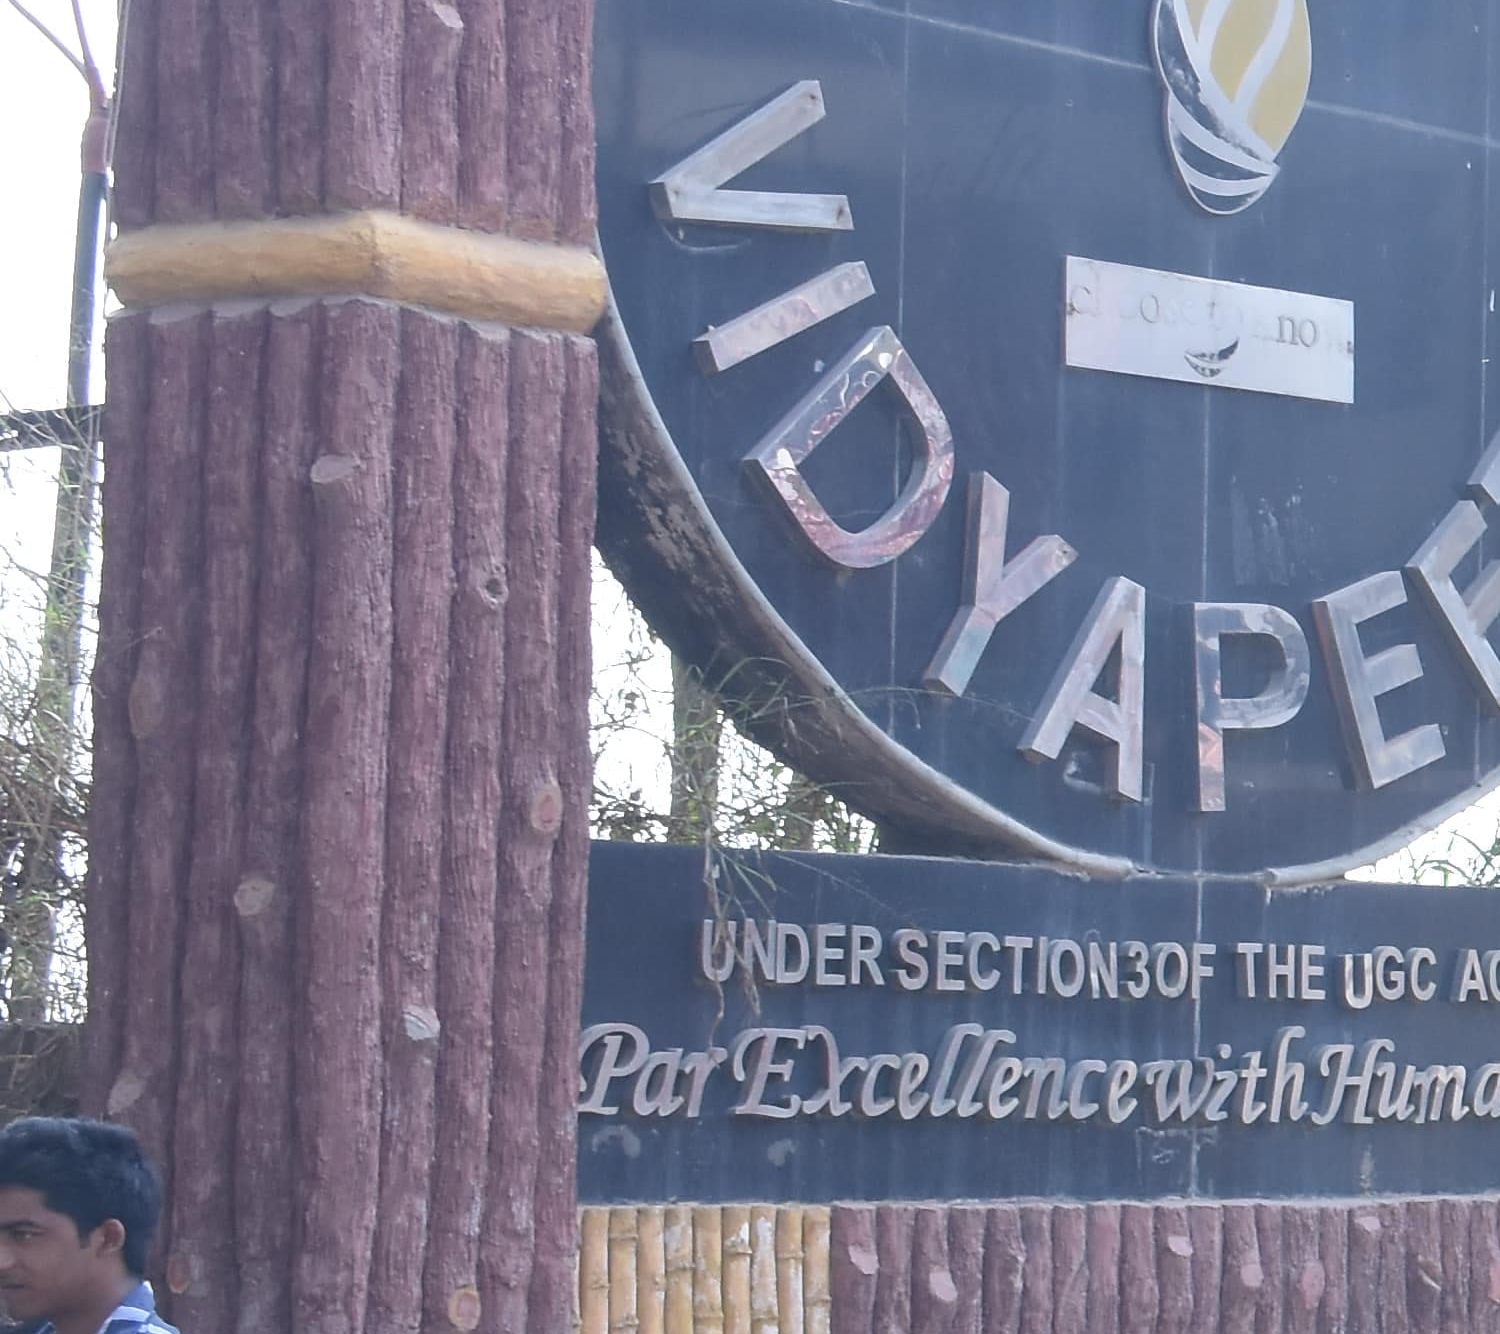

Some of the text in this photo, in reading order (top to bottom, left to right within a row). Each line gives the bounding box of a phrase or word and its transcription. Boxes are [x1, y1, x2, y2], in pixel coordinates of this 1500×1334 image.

[702, 917, 885, 985] UNDER
[1237, 942, 1326, 1002] THE
[1340, 946, 1438, 1009] UGC
[576, 1022, 727, 1118] Par
[733, 1022, 1138, 1123] Excellence
[1146, 1025, 1308, 1125] with
